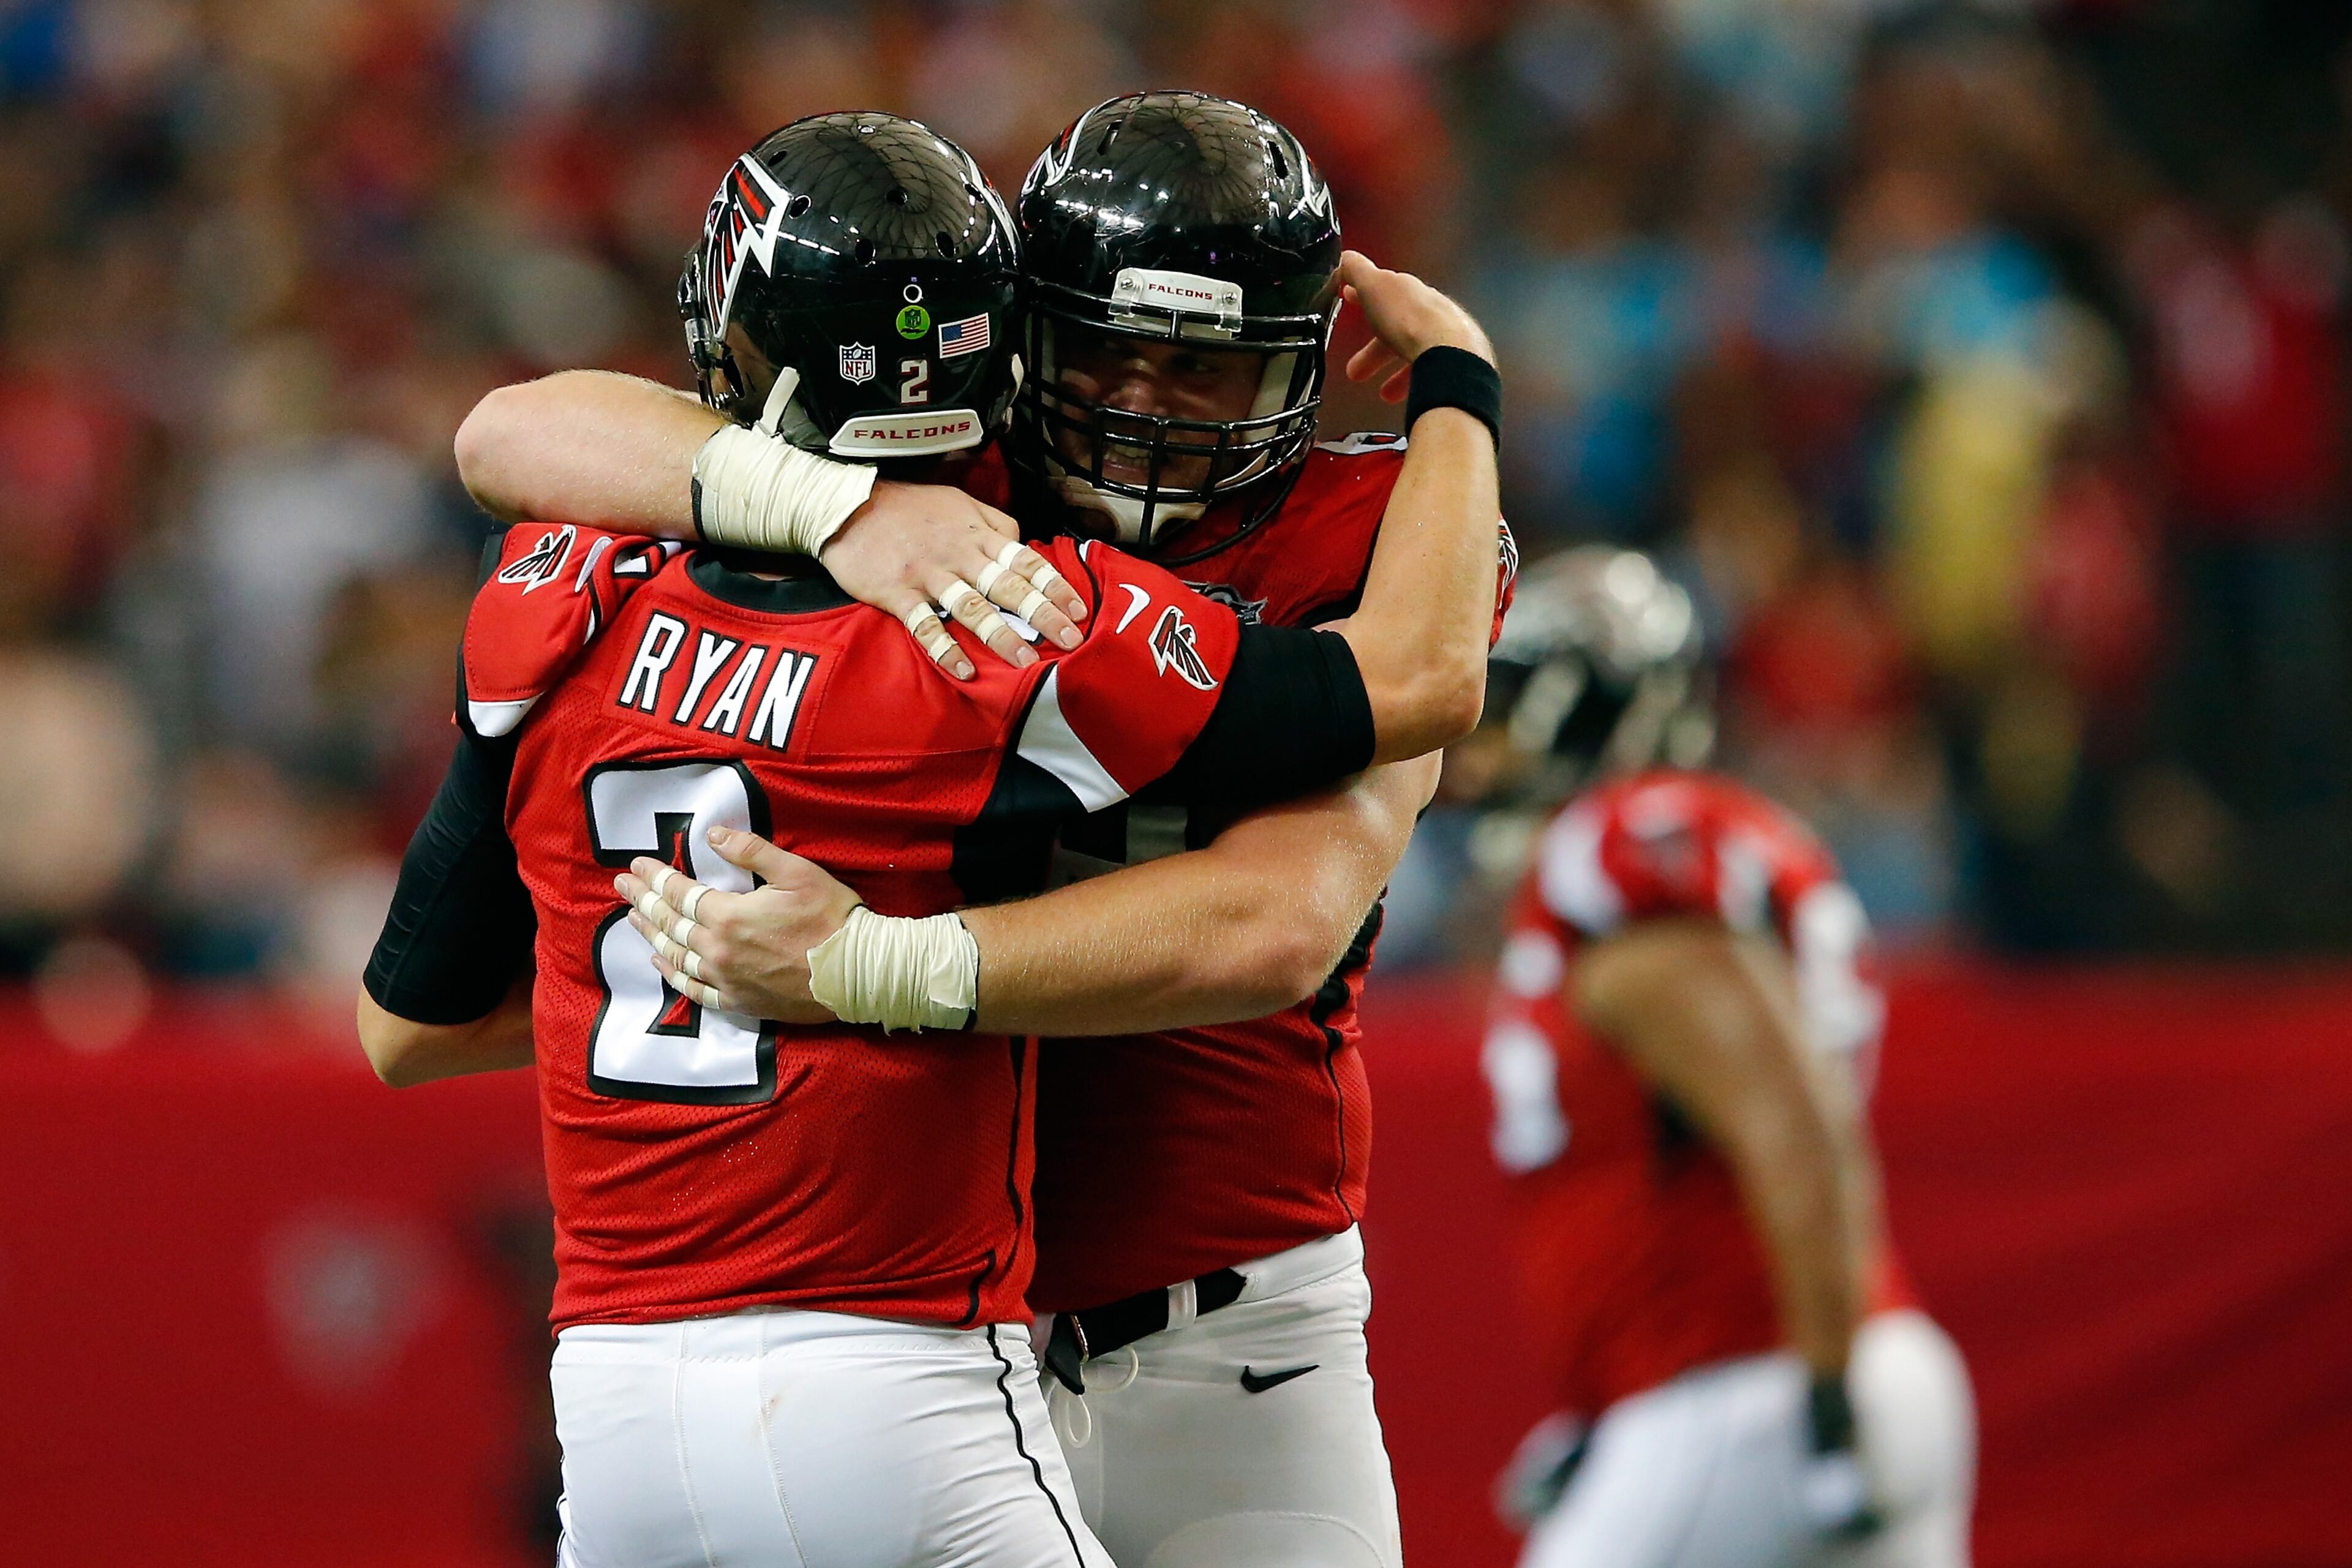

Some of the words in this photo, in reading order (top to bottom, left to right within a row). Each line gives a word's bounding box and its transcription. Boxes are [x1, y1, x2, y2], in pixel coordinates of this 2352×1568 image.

[1148, 283, 1212, 300] FALCONS
[845, 360, 870, 377] NFL
[900, 359, 929, 405] 2
[854, 421, 970, 439] FALCONS
[618, 610, 818, 752] RYAN
[583, 760, 773, 1101] 2
